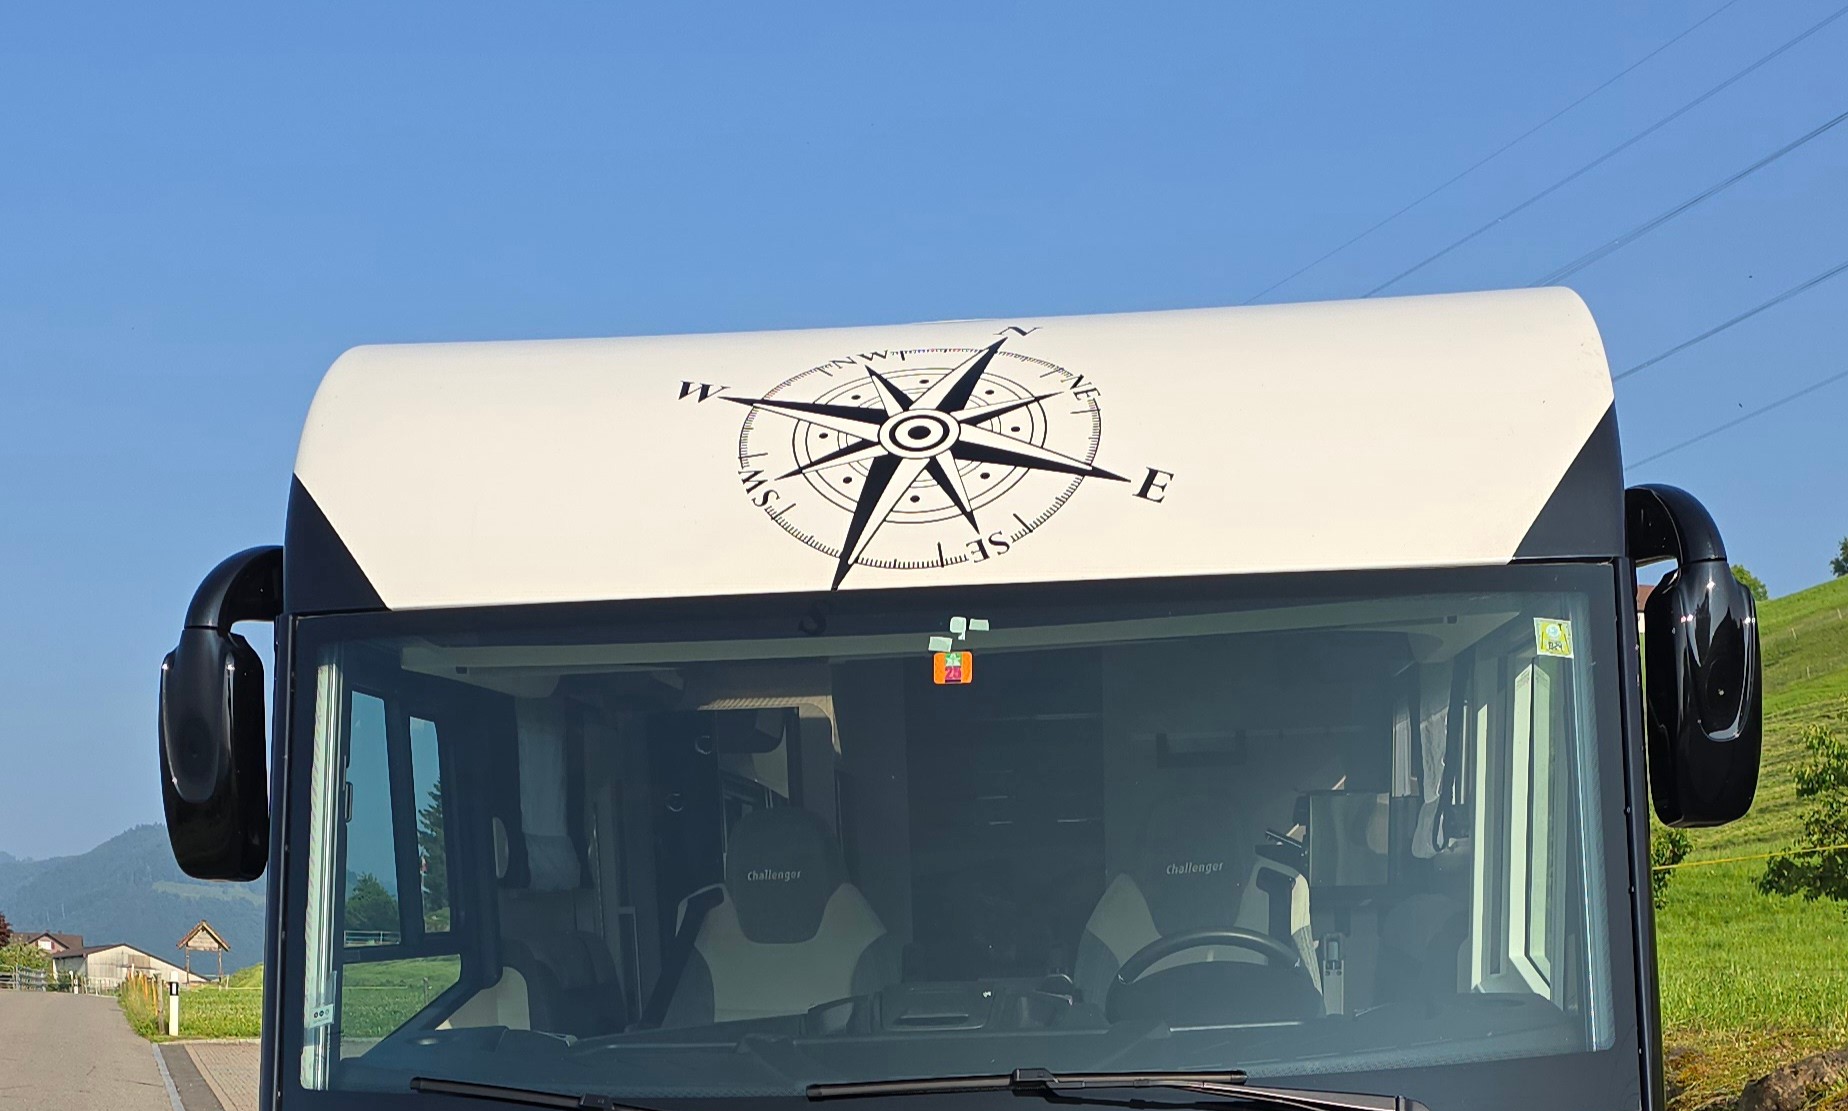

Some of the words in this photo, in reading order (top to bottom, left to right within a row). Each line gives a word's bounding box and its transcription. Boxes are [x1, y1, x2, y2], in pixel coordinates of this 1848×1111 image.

[993, 326, 1043, 337] N
[829, 350, 889, 370] NW
[678, 380, 731, 404] W
[1060, 374, 1101, 401] NE
[738, 469, 780, 508] SW
[1132, 466, 1174, 504] E
[965, 530, 1010, 564] SE
[799, 599, 832, 636] S
[747, 869, 801, 882] Challenger
[1166, 862, 1224, 875] Challenger
